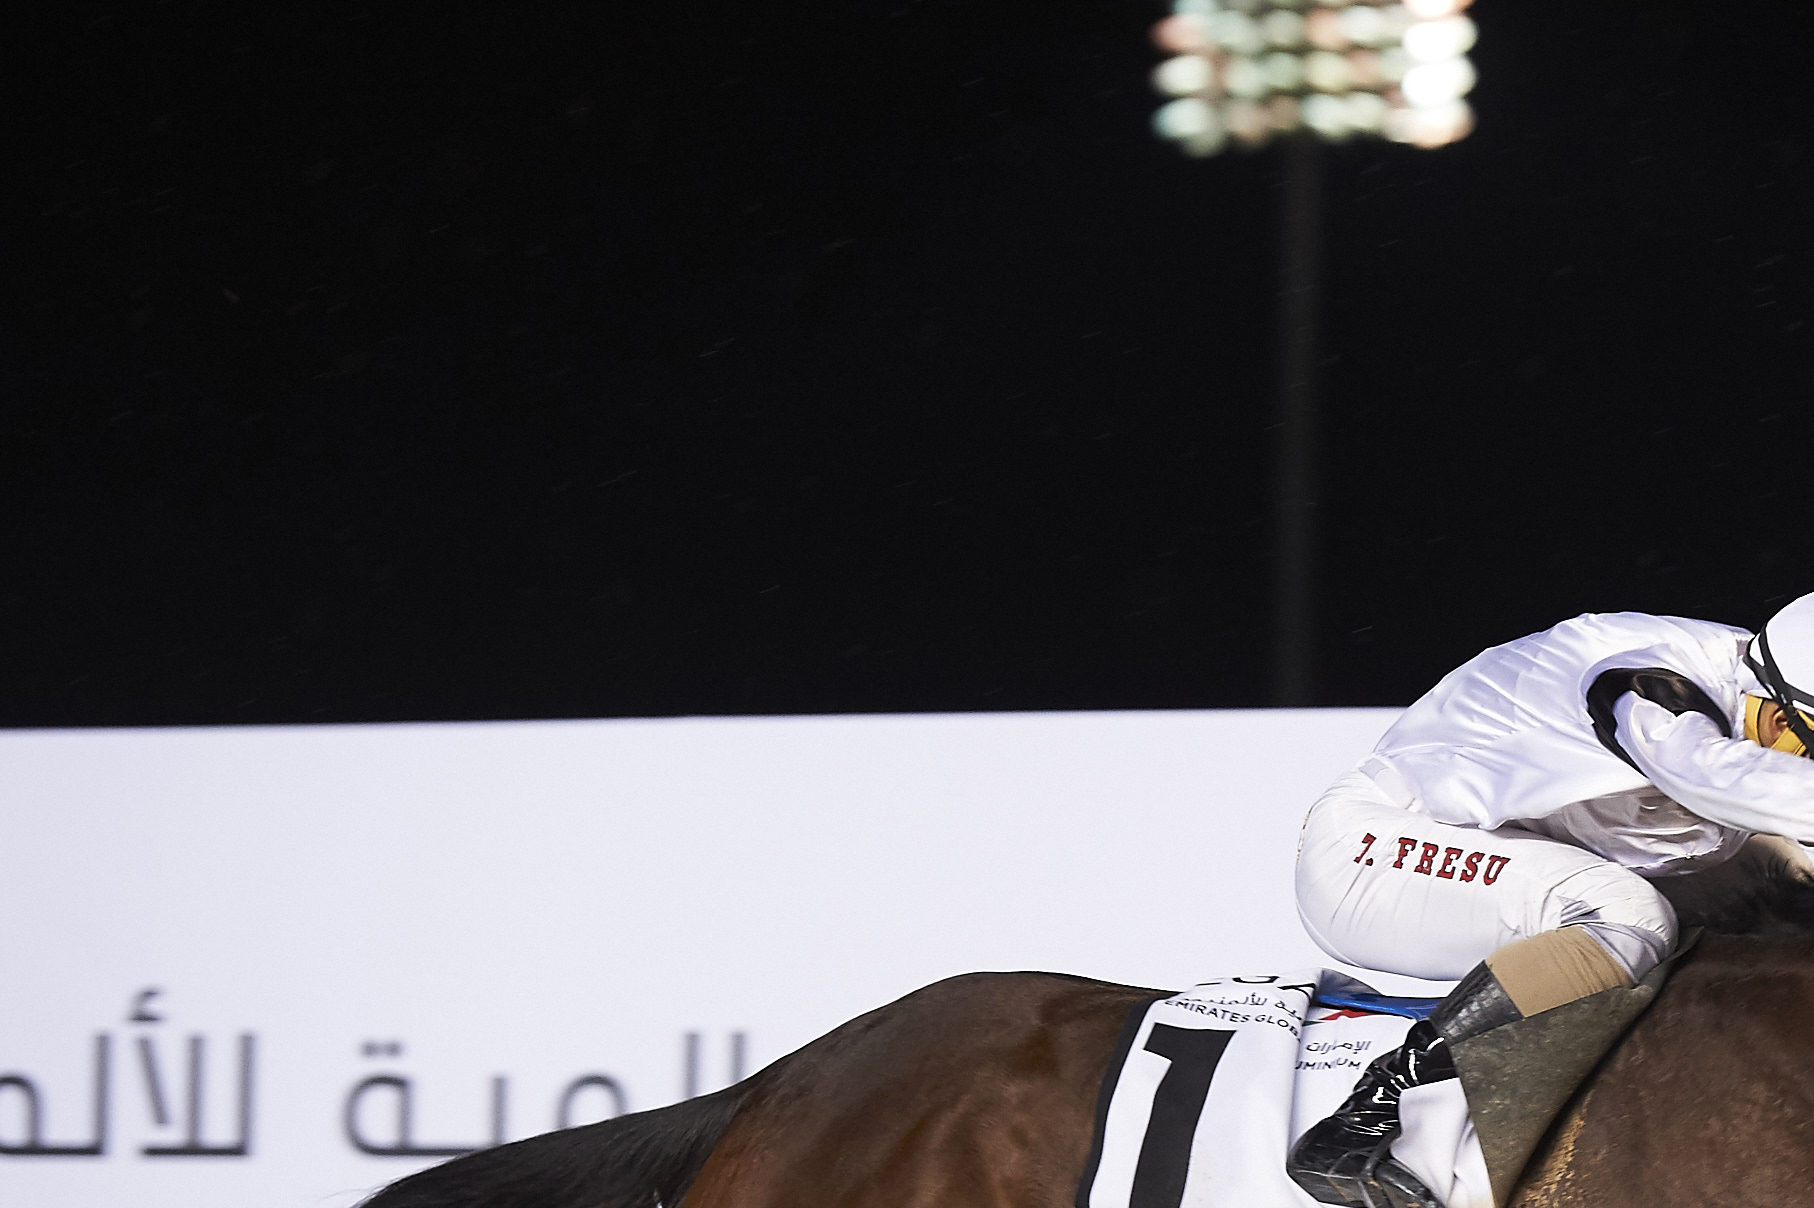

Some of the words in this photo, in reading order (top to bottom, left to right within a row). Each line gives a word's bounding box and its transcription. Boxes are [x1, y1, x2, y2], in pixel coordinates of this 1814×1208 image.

[1392, 836, 1511, 886] FRESU
[1164, 1000, 1251, 1023] EMIRATES
[1254, 1014, 1301, 1043] GLOB
